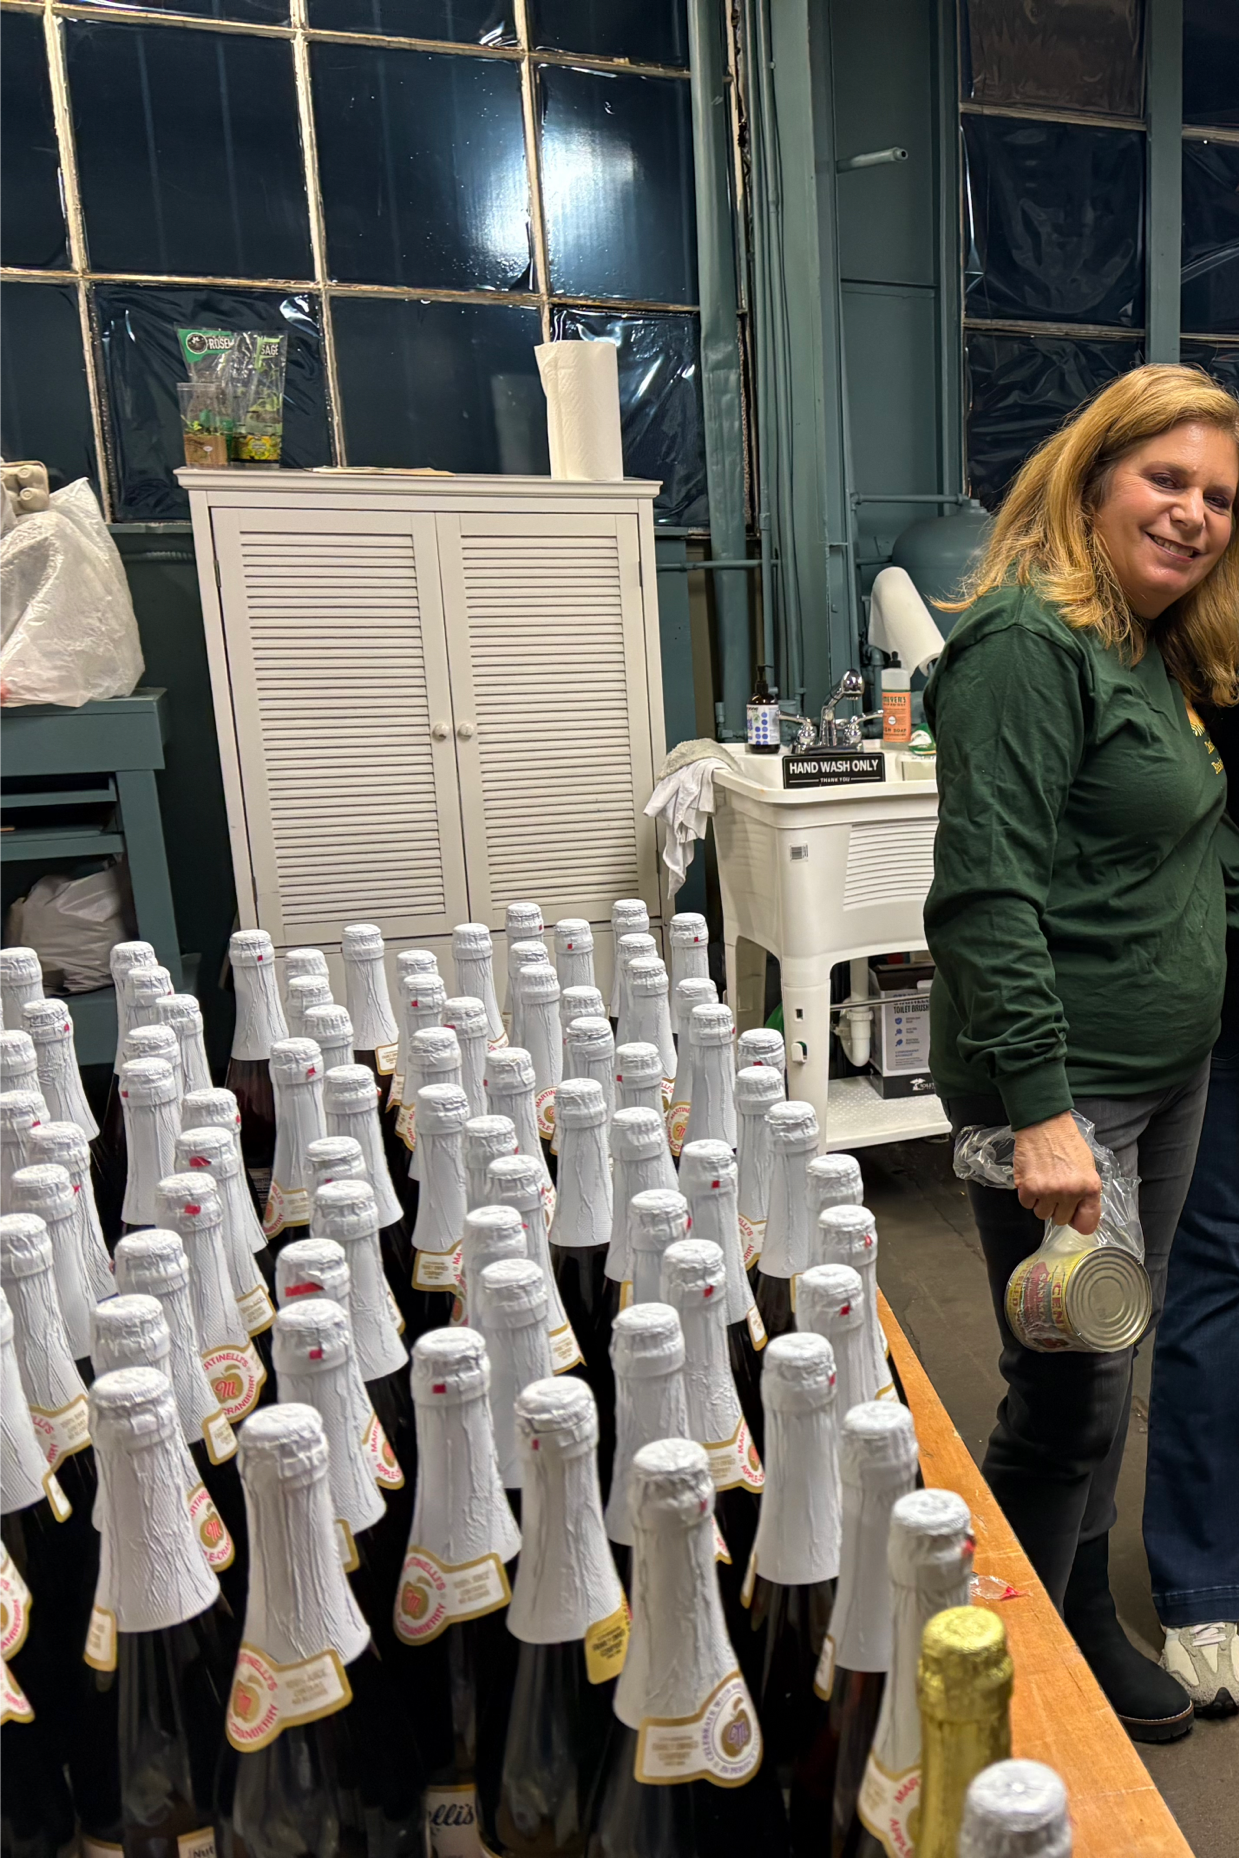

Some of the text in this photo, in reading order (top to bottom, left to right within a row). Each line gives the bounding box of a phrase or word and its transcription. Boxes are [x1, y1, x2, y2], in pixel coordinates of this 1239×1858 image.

[260, 344, 279, 356] SAGE
[789, 758, 879, 775] HAND WASH ONLY
[894, 1004, 911, 1014] TOILET
